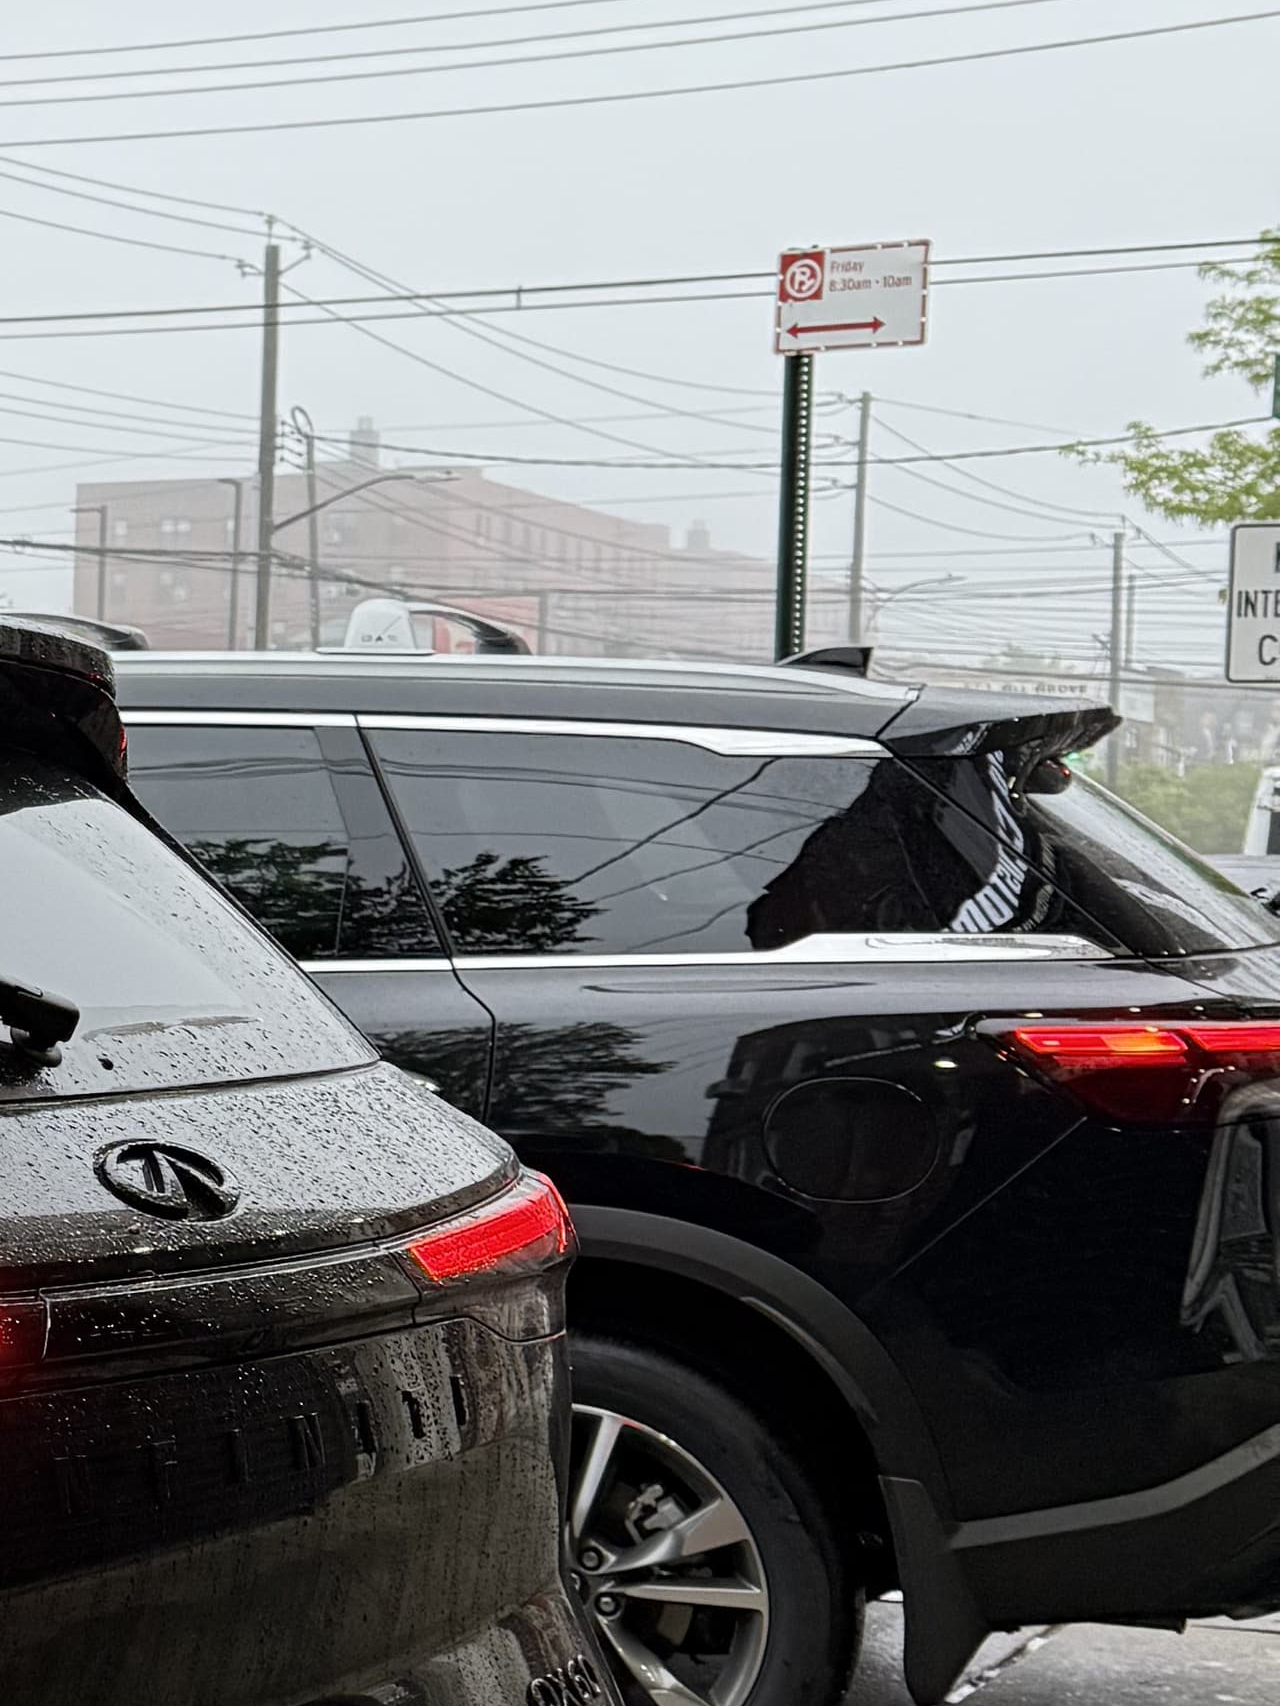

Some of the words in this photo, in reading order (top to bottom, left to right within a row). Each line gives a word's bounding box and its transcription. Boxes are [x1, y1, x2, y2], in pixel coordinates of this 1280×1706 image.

[829, 259, 865, 274] Friday
[828, 277, 872, 293] 8:30am
[882, 275, 913, 289] 10am
